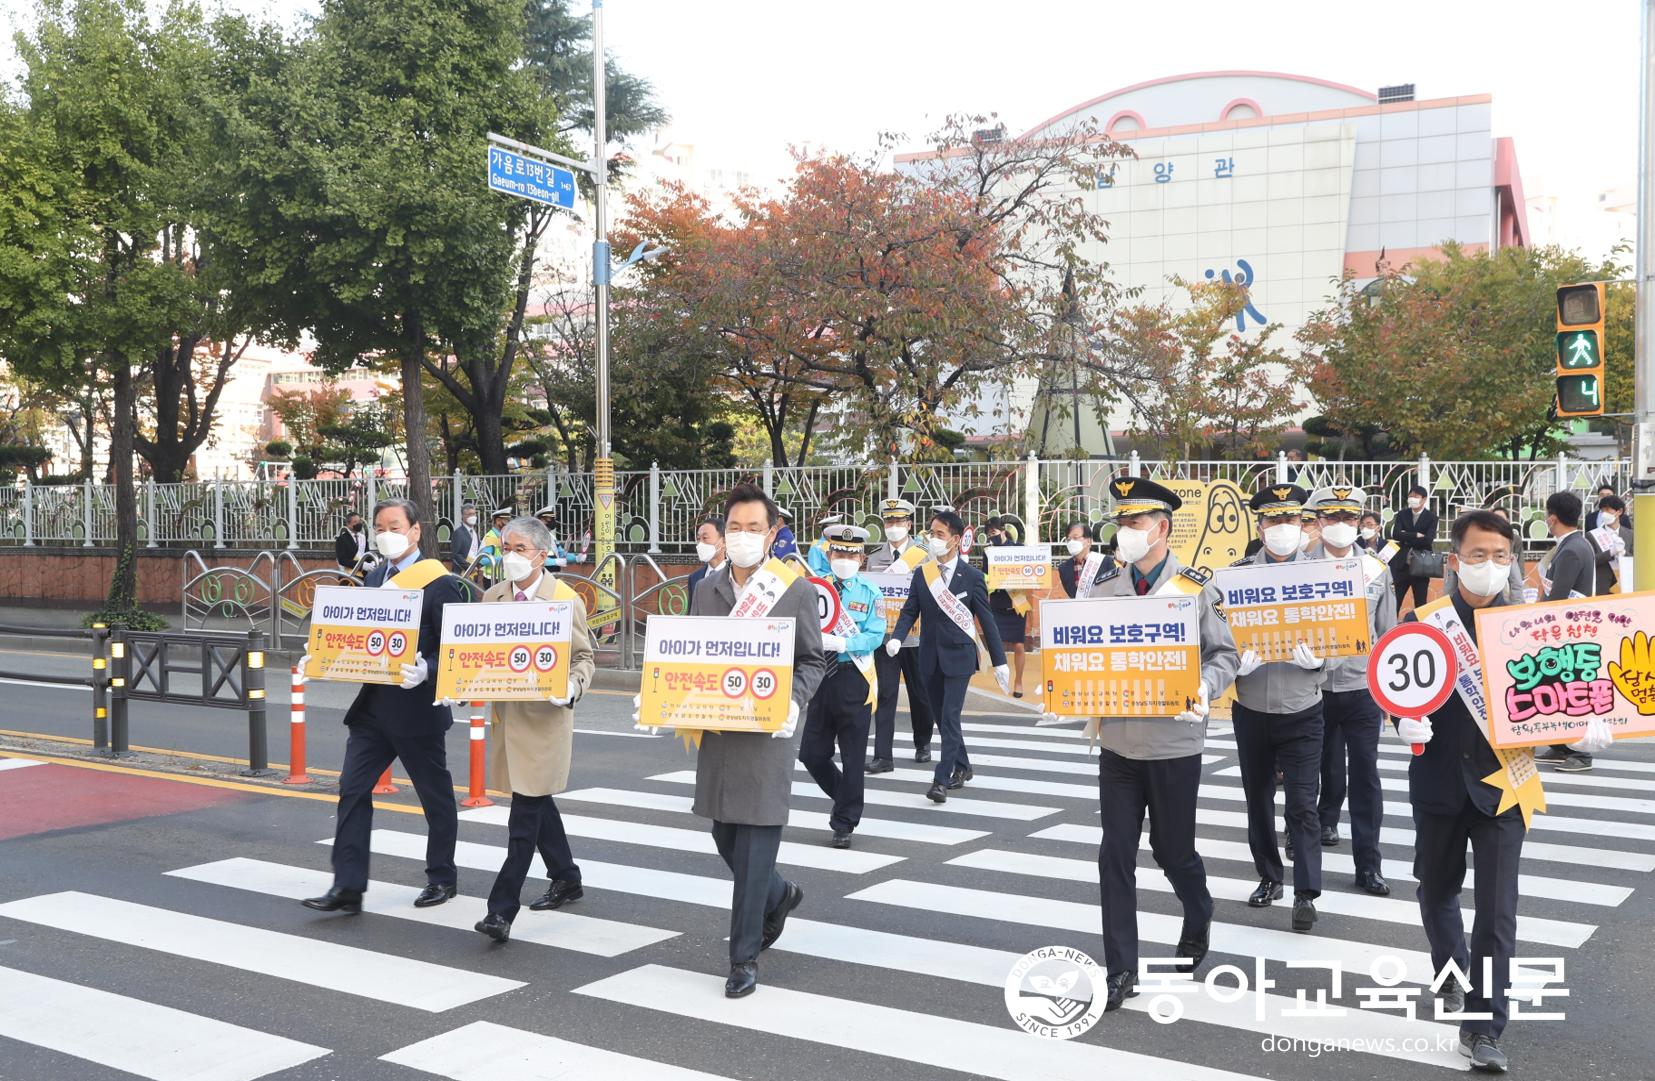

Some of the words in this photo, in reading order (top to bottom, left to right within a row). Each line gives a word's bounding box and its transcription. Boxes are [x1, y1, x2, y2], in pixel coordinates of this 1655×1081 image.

[492, 151, 555, 187] 가음로13번길
[492, 173, 525, 193] Gaeum-ro
[527, 183, 560, 204] 13beon-gil
[1581, 380, 1598, 405] 4
[1228, 586, 1277, 606] 비워요
[1281, 580, 1354, 602] 보호구역!
[323, 605, 354, 620] 아이가
[356, 607, 411, 622] 먼저입니다!
[818, 594, 828, 619] 0
[1230, 608, 1279, 628] 채워요
[1284, 602, 1356, 624] 통학안전!
[325, 632, 365, 650] 안전속도
[370, 637, 382, 647] 50
[391, 638, 403, 649] 30
[454, 623, 491, 637] 아이가
[494, 621, 560, 637] 먼저입니다!
[1053, 625, 1104, 645] 비워요
[1109, 622, 1186, 643] 보호구역!
[1530, 625, 1562, 642] 작은
[459, 651, 506, 669] 안전속도
[514, 652, 527, 663] 50
[539, 652, 552, 663] 30
[659, 639, 702, 656] 아이가
[705, 640, 781, 658] 먼저입니다!
[1053, 652, 1105, 672] 채워요
[1110, 650, 1187, 672] 통학안전!
[1453, 631, 1480, 667] 비워요
[1387, 649, 1436, 692] 30
[1506, 642, 1602, 691] 보행중
[664, 671, 718, 692] 안전속도
[727, 675, 742, 688] 50
[756, 676, 771, 689] 30
[1506, 679, 1614, 722] 스마트폰
